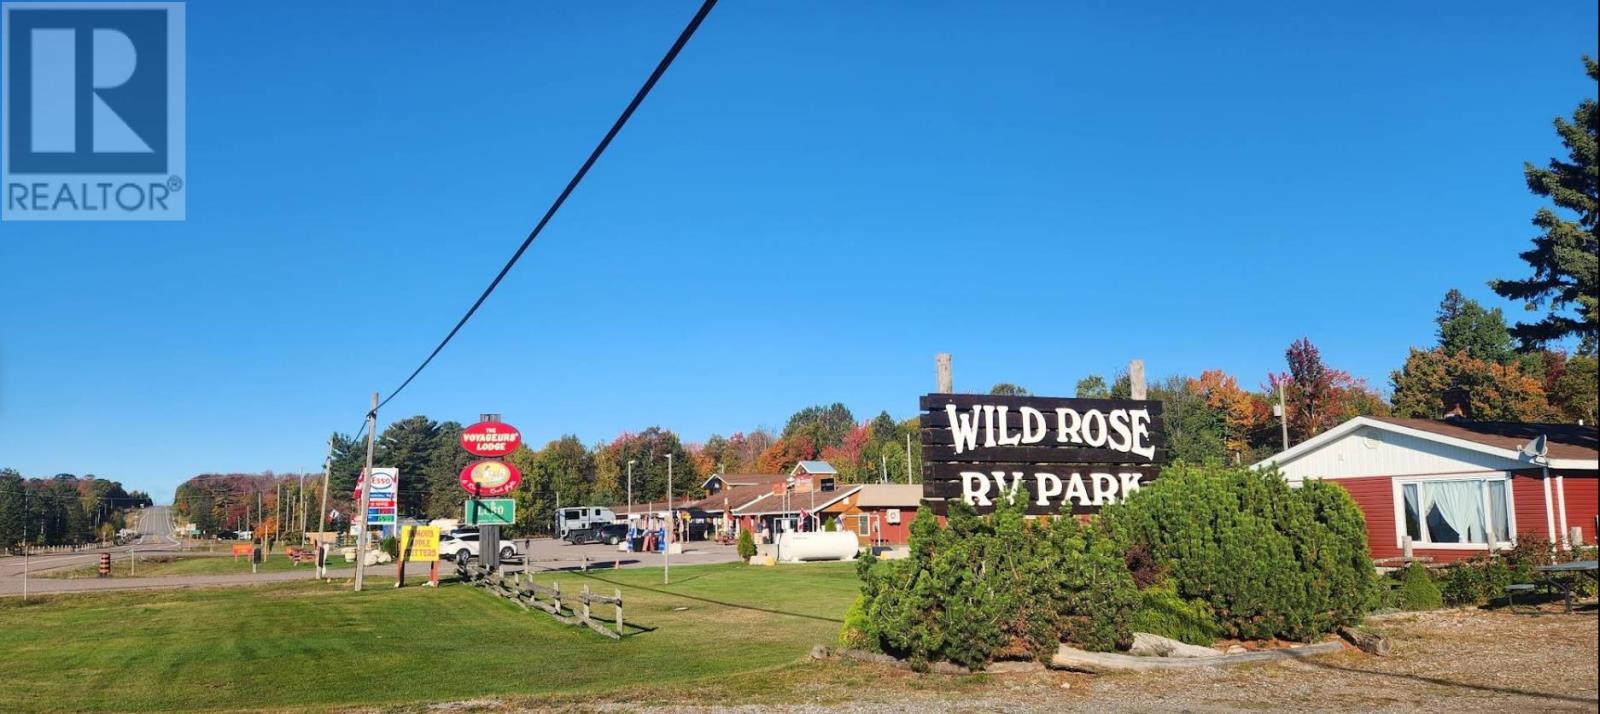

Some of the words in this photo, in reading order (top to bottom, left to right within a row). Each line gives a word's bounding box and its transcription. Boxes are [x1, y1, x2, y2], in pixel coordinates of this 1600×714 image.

[476, 442, 506, 451] LODGE
[946, 403, 1047, 454] WILD
[1055, 407, 1156, 461] ROSE
[960, 471, 1024, 506] RV
